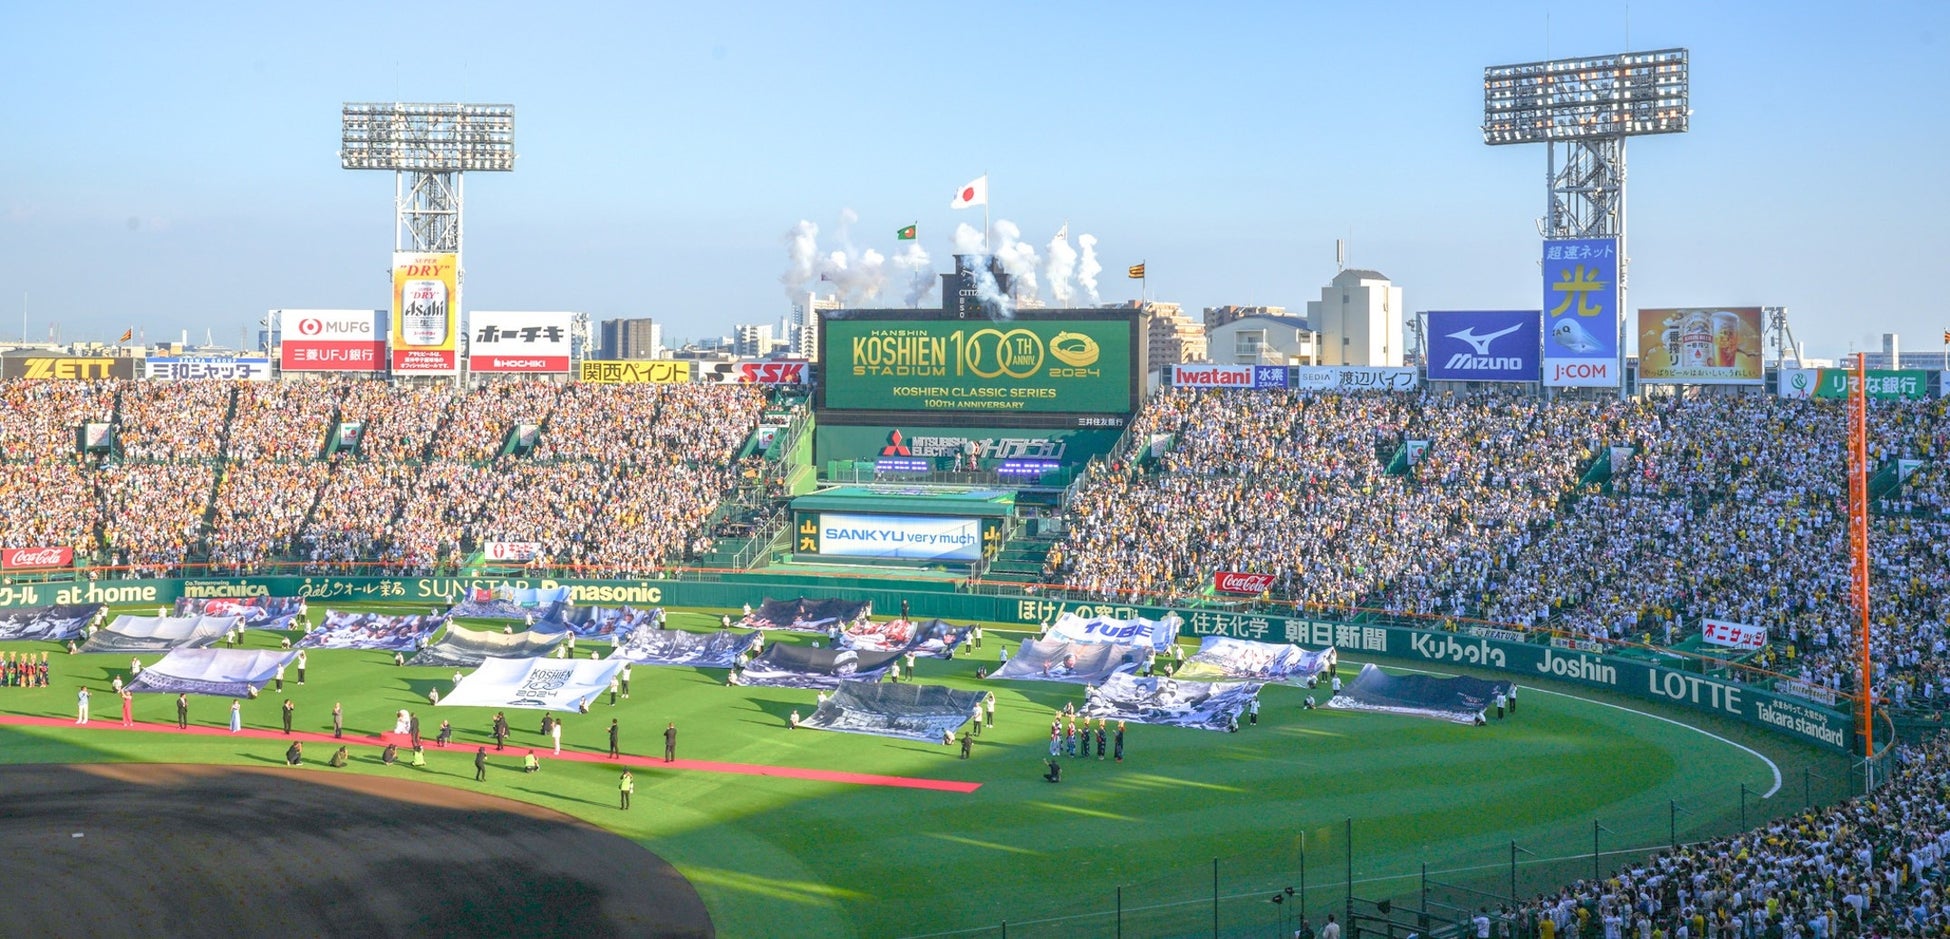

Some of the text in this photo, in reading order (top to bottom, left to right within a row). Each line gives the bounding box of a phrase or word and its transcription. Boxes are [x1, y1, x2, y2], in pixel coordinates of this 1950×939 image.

[1547, 245, 1613, 260] 超速ネット
[1550, 262, 1610, 318] 光
[405, 300, 444, 316] Asahi
[326, 322, 370, 333] MUFG
[476, 325, 564, 342] ホーチキ
[294, 349, 374, 360] 三菱UFJ銀行
[853, 337, 945, 366] KOSHIEN
[951, 328, 1044, 379] 100
[1016, 338, 1032, 354] TH
[24, 358, 114, 379] ZETT
[1444, 353, 1522, 370] MIZUNO
[154, 364, 261, 379] 三和シャッター
[583, 363, 688, 382] 関西ペイント
[738, 364, 804, 382] SSK
[853, 366, 945, 376] STADIUM
[1049, 368, 1100, 377] 2024
[1176, 368, 1250, 385] Iwatani
[1259, 368, 1283, 381] 水素
[1340, 371, 1416, 386] 渡辺パイプ
[1554, 364, 1606, 381] J:COM
[893, 387, 1056, 398] KOSHIEN CLASSIC SERIES
[1834, 376, 1916, 394] りそな銀行
[925, 400, 1024, 409] 100TH ANNIVERSARY
[1078, 418, 1123, 426] 三井住友銀行
[800, 520, 816, 551] 山九
[826, 528, 975, 545] SANKYU very much
[12, 550, 61, 565] Coca-Cola
[541, 580, 661, 603] Pnasonic
[1222, 574, 1268, 593] Coca-Cola
[56, 582, 156, 605] at home
[1085, 622, 1156, 638] TUBE
[1190, 612, 1269, 639] 住友化学
[1285, 620, 1387, 652] 朝日新聞
[1411, 632, 1506, 668] Kubota
[531, 668, 574, 680] KOSHIEN
[1537, 649, 1616, 685] Joshin
[516, 690, 558, 698] 2024
[1650, 669, 1742, 714] LOTTE
[1756, 702, 1843, 747] Takara standard
